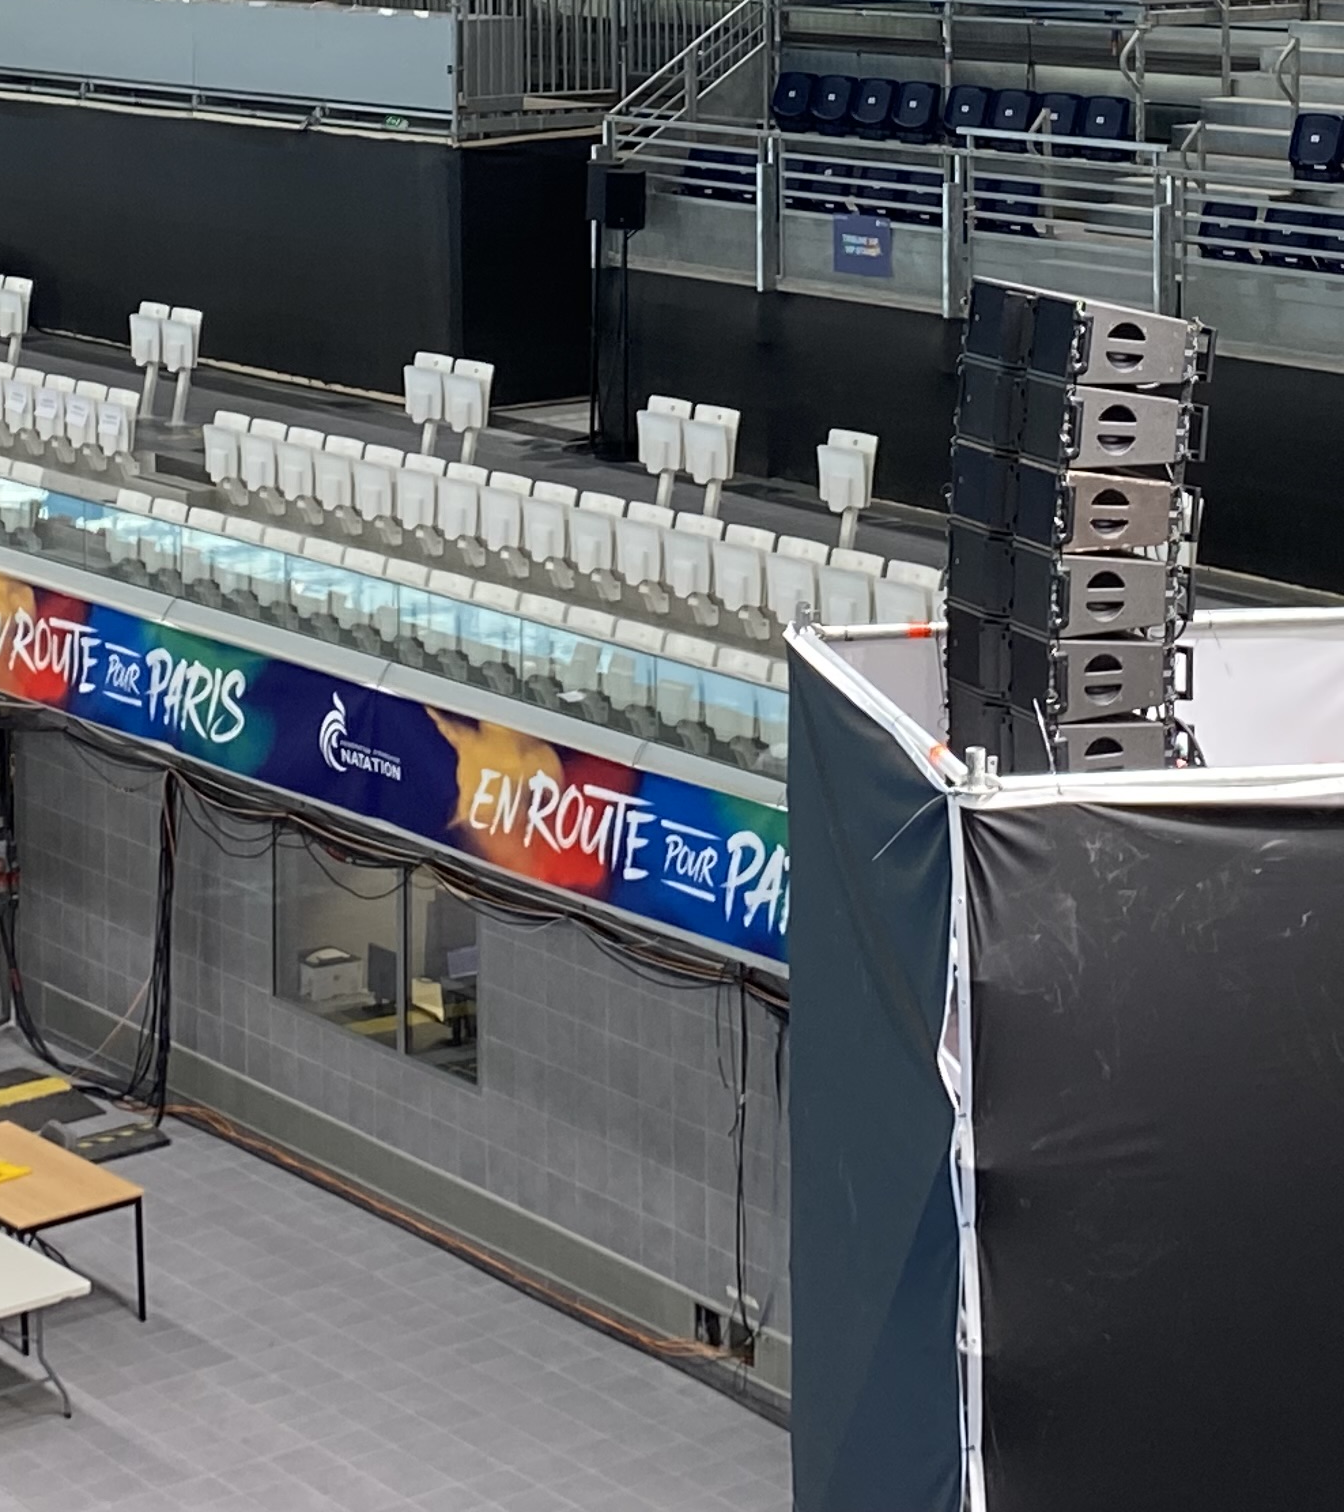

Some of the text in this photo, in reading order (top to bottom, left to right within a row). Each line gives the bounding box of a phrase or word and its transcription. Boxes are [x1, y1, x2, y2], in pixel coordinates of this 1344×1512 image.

[8, 607, 102, 694] ROUTE
[105, 653, 141, 694] POUR
[145, 647, 247, 744] PARIS
[340, 747, 402, 781] NATATION
[468, 768, 791, 936] EN ROUTE POUR PA
